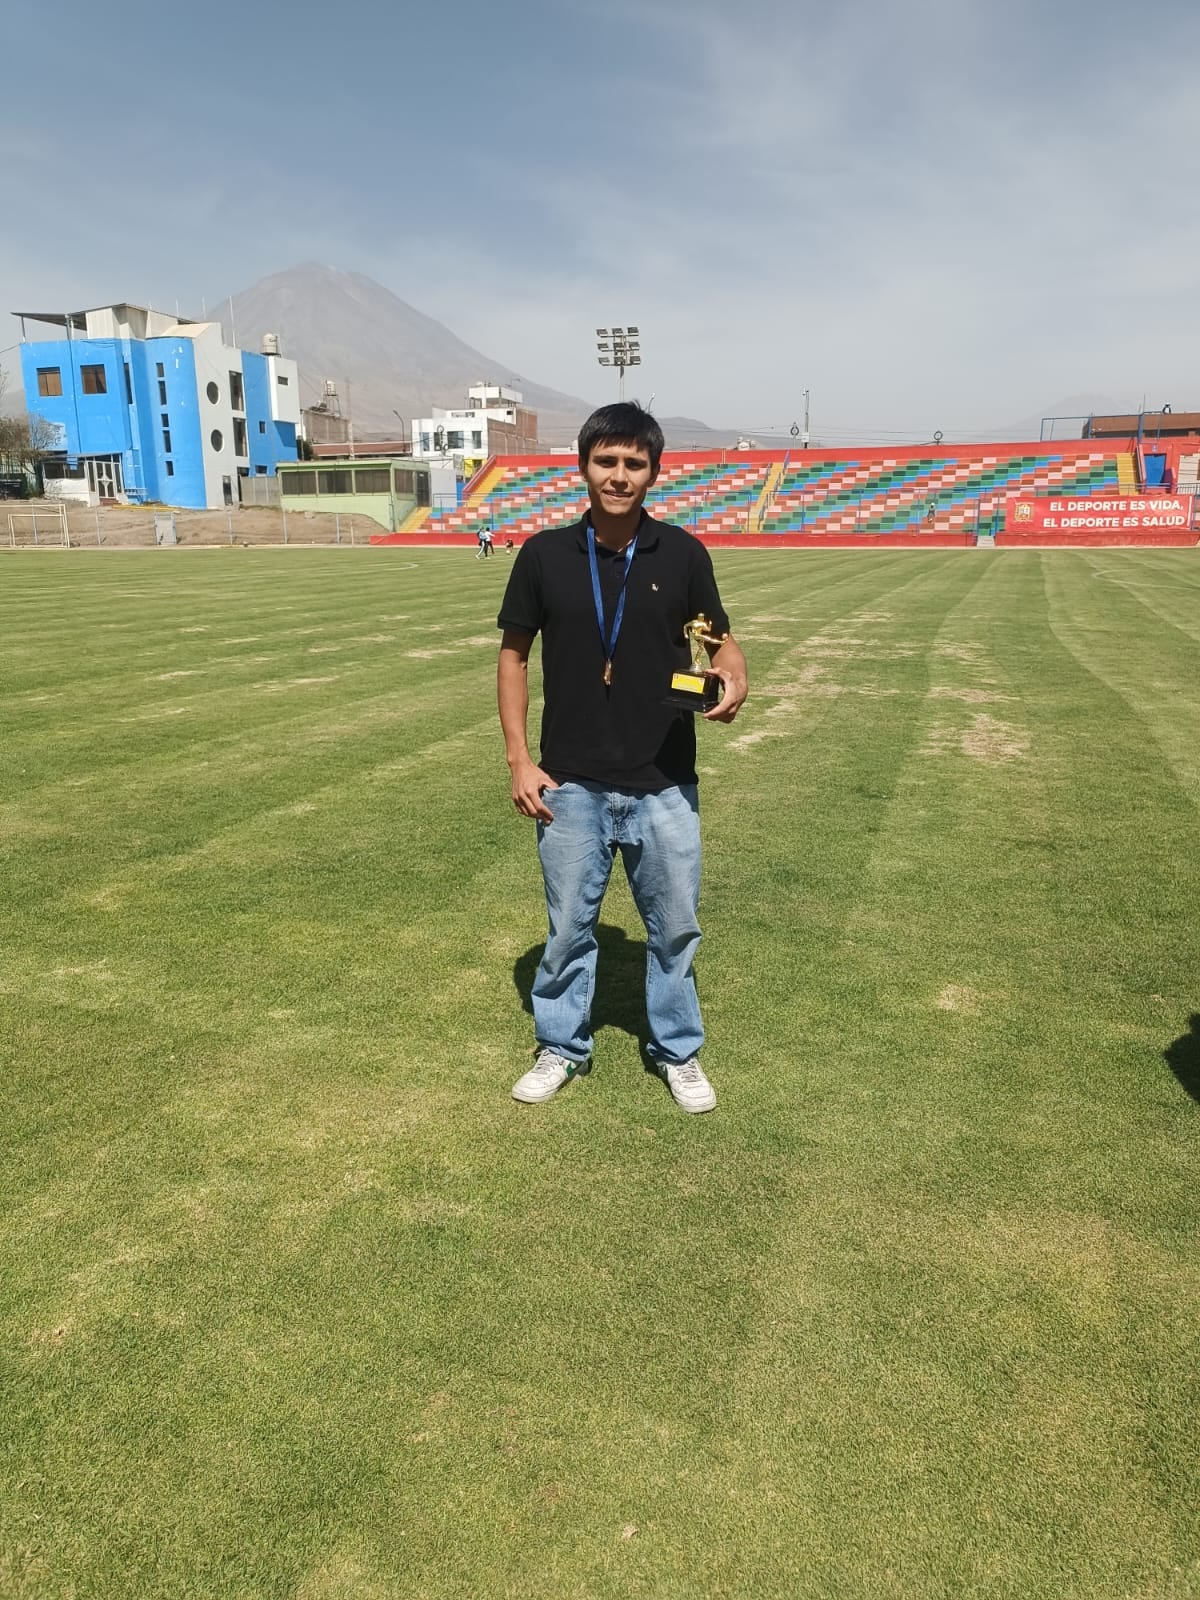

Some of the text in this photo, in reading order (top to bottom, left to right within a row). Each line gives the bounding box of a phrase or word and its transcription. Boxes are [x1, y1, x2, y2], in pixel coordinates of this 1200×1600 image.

[1050, 502, 1064, 511] EL
[1068, 501, 1125, 511] DEPORTE
[1130, 501, 1145, 511] ES
[1043, 516, 1185, 528] EL DEPORTE ES SALUD
